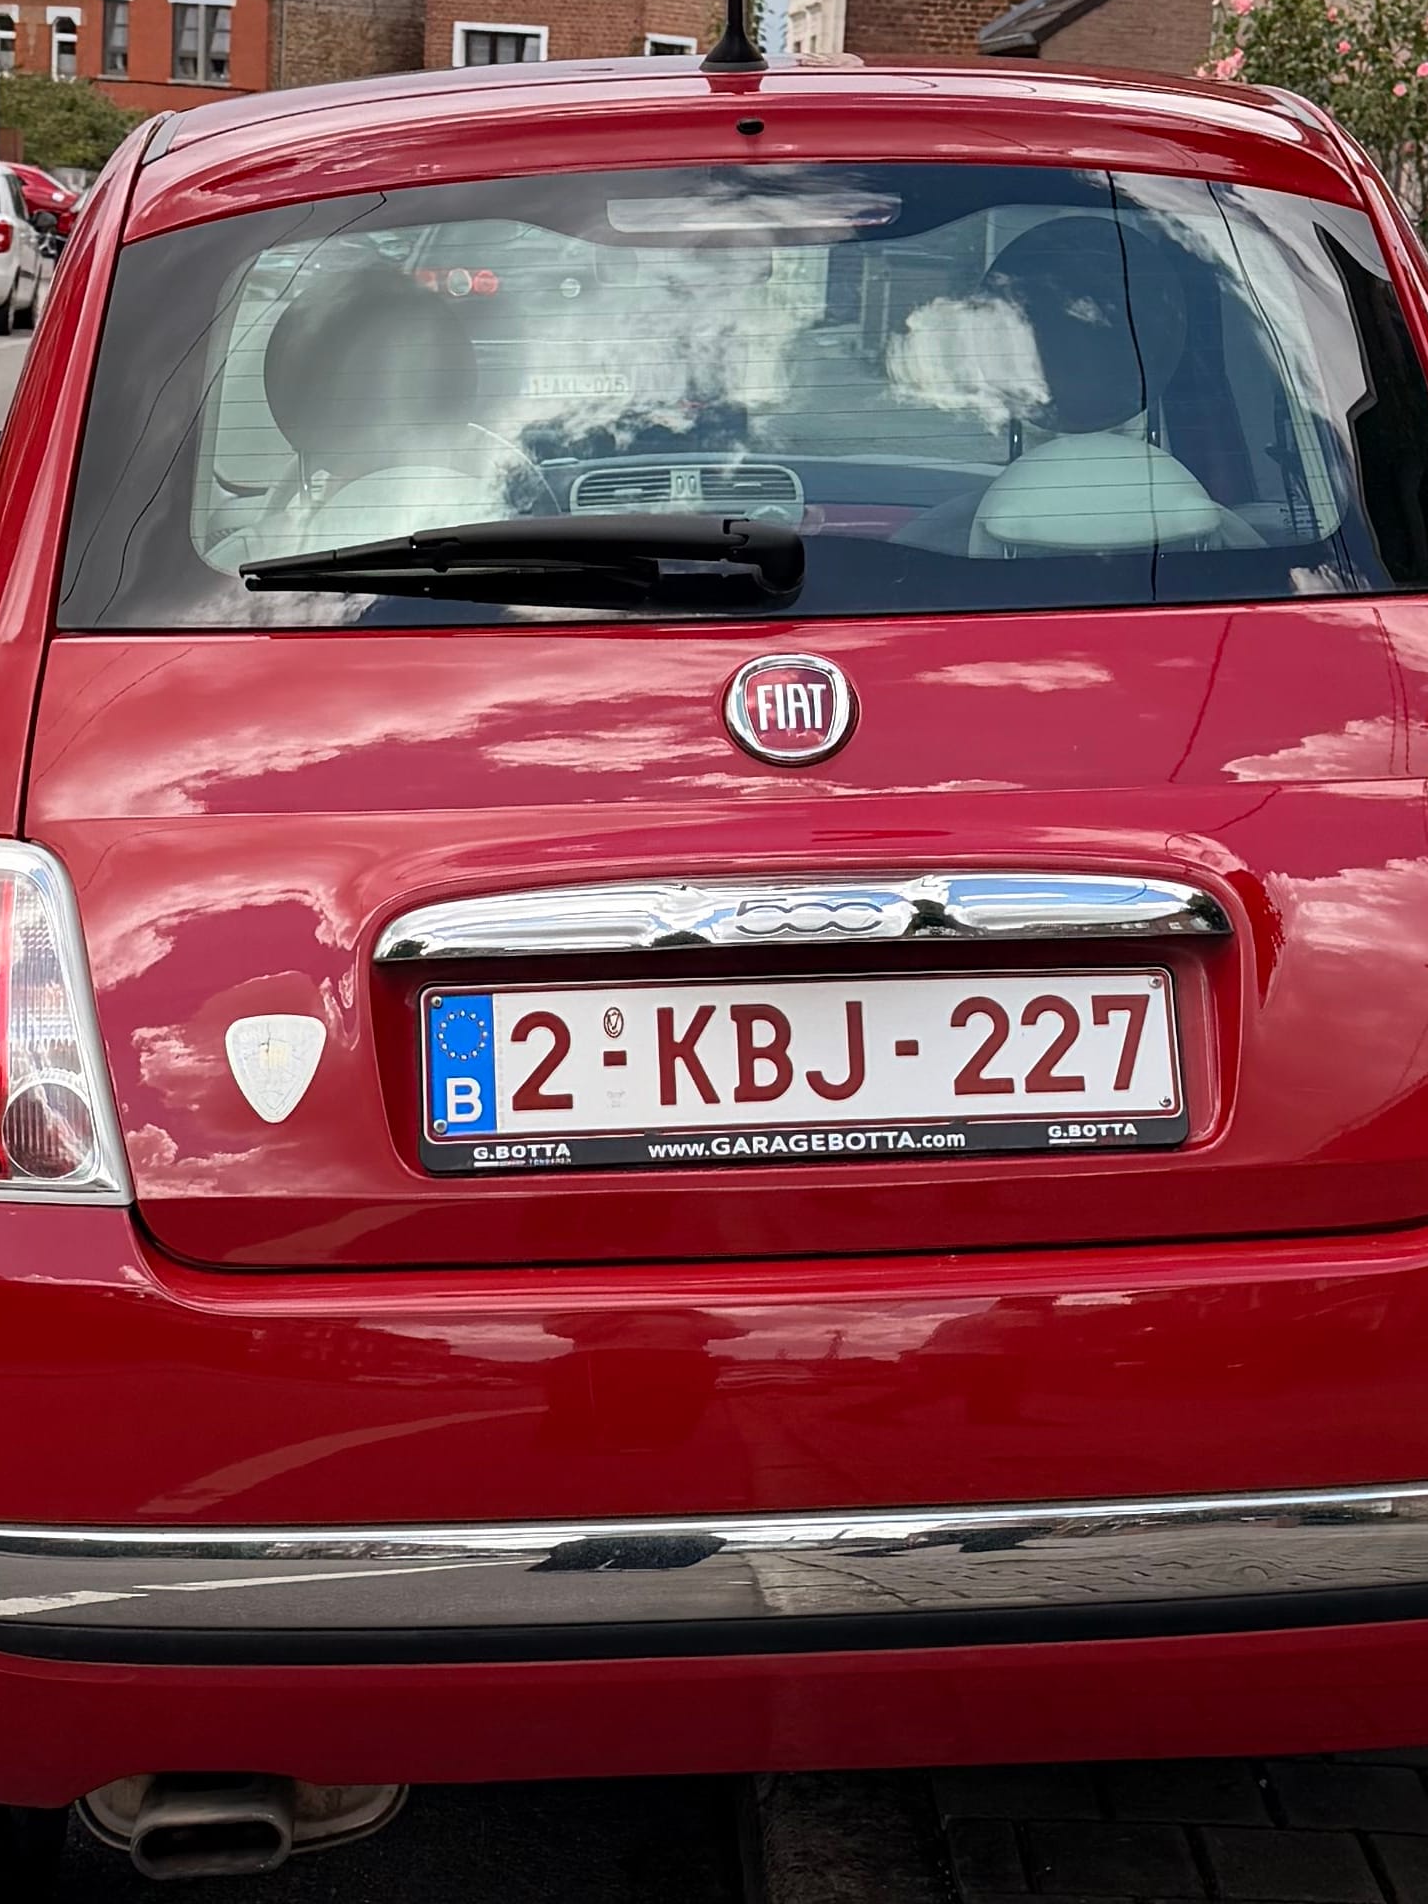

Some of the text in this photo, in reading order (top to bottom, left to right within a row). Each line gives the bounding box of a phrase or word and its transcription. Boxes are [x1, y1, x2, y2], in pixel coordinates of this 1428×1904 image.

[756, 683, 826, 730] FIAT
[510, 994, 1150, 1112] 2-KBJ-227
[446, 1077, 483, 1123] B
[648, 1131, 966, 1159] www.GARAGEBOTTA.com
[1048, 1123, 1138, 1138] G.BOTTA
[473, 1143, 571, 1160] G.BOTTA
